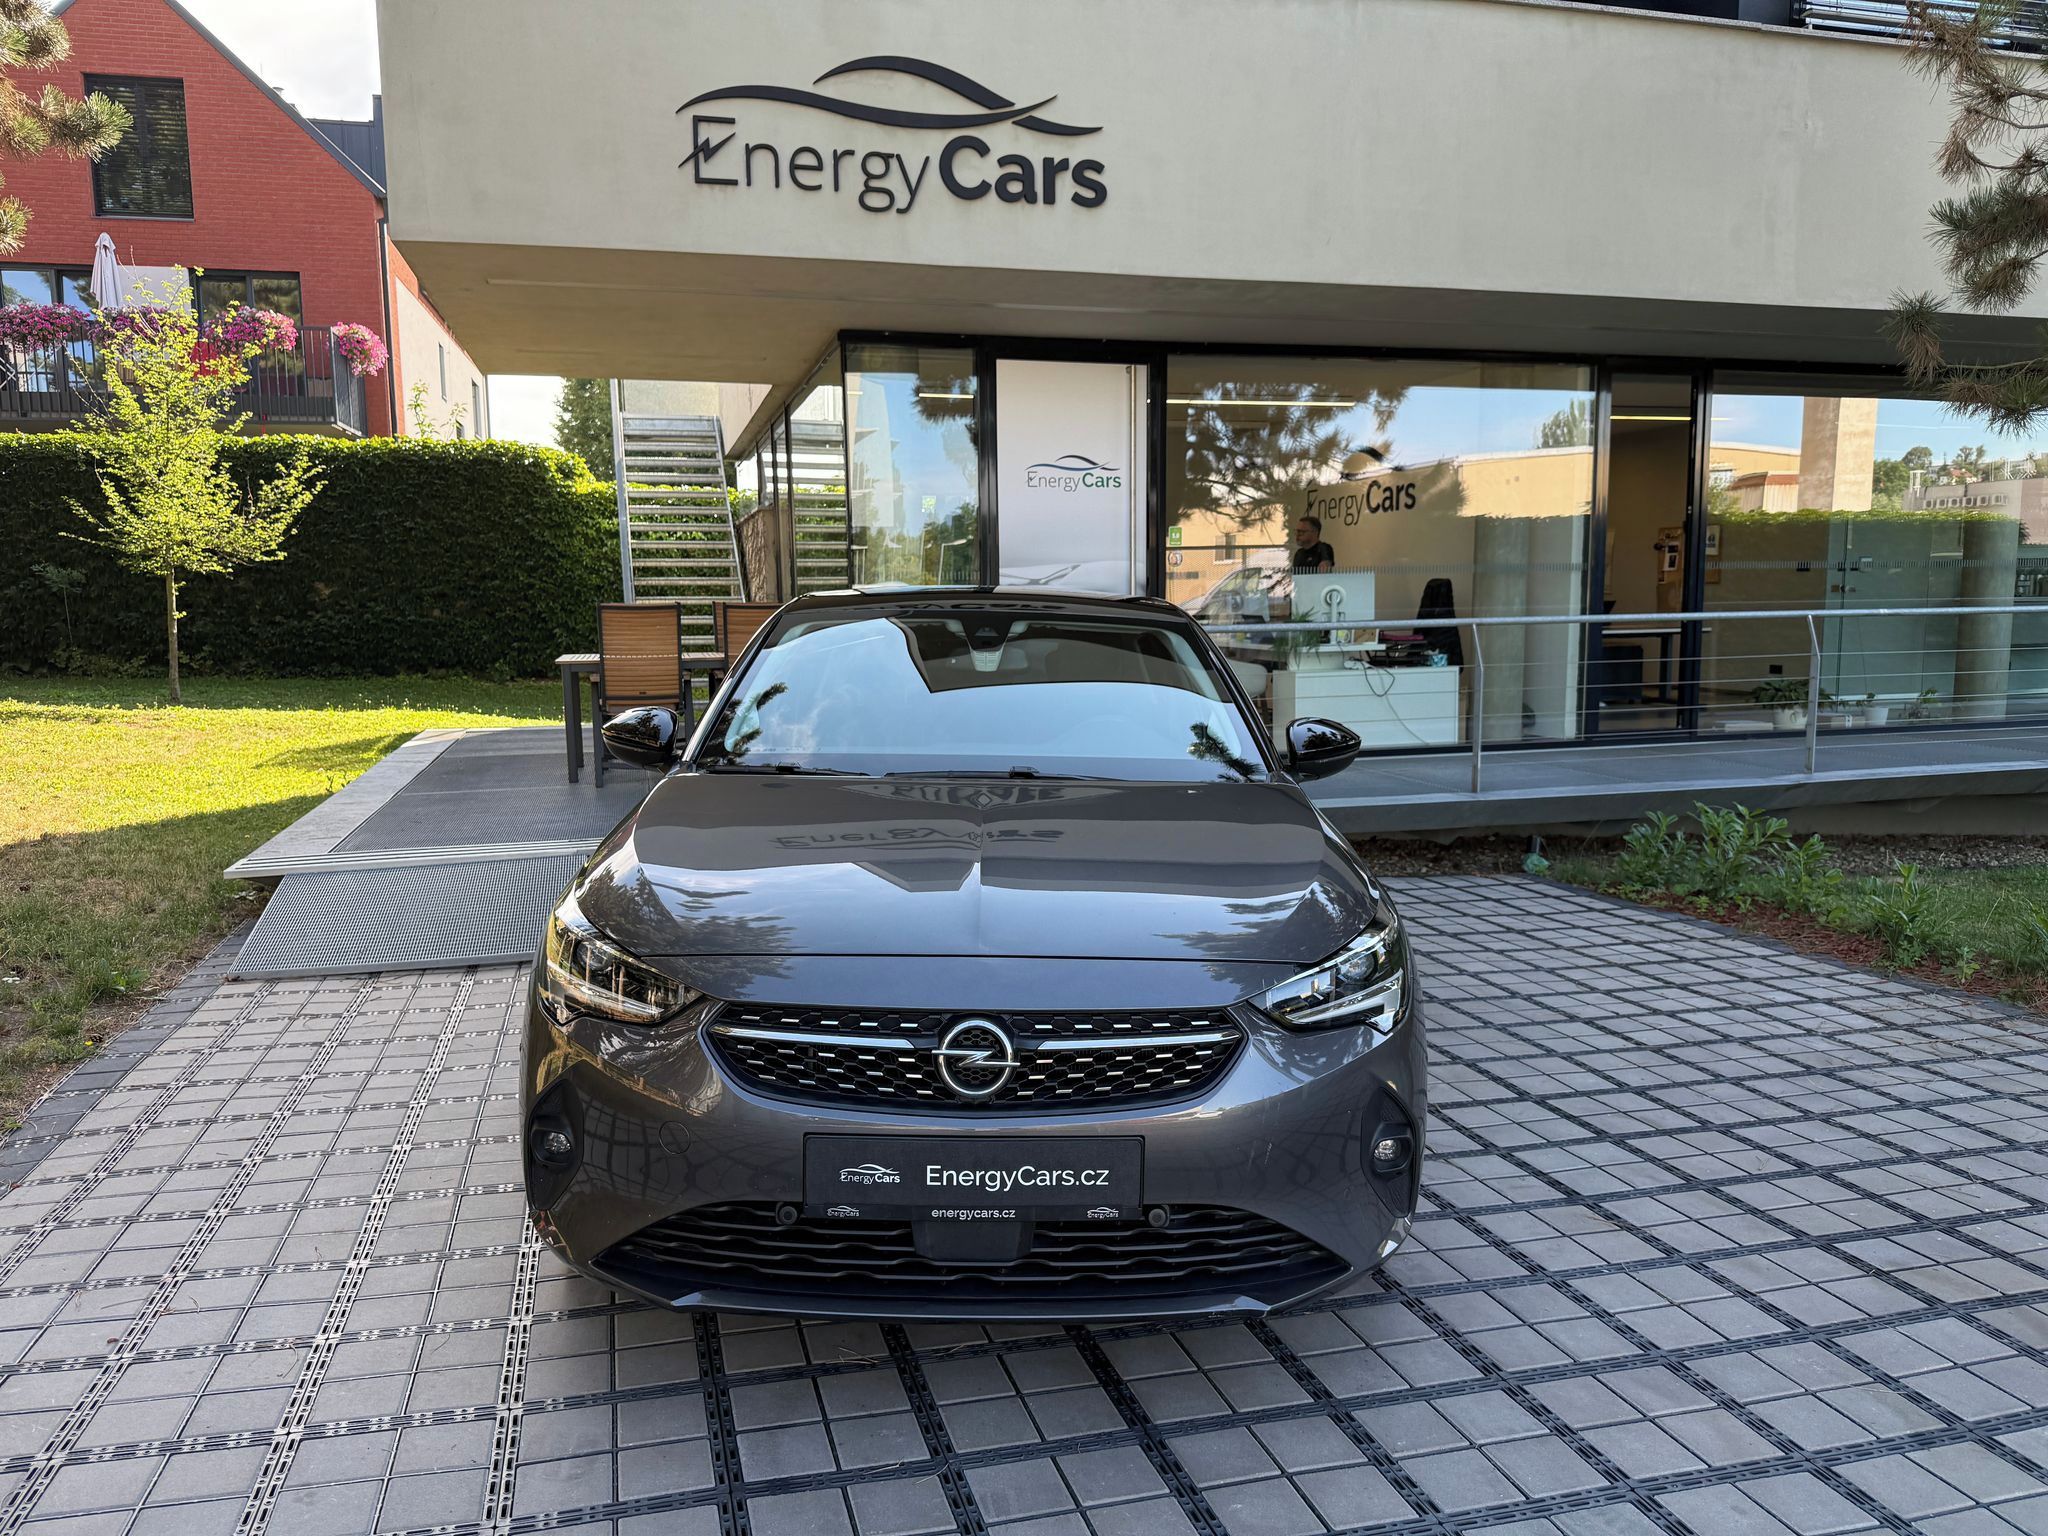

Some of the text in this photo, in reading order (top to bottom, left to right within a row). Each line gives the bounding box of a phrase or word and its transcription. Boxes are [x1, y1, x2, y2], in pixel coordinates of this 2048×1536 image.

[679, 114, 1108, 213] EnergyCars
[1026, 471, 1122, 492] EnergyCars
[840, 1172, 901, 1185] EnergyCars
[926, 1165, 1109, 1191] EnergyCars.cz
[931, 1208, 1016, 1221] energycars.cz
